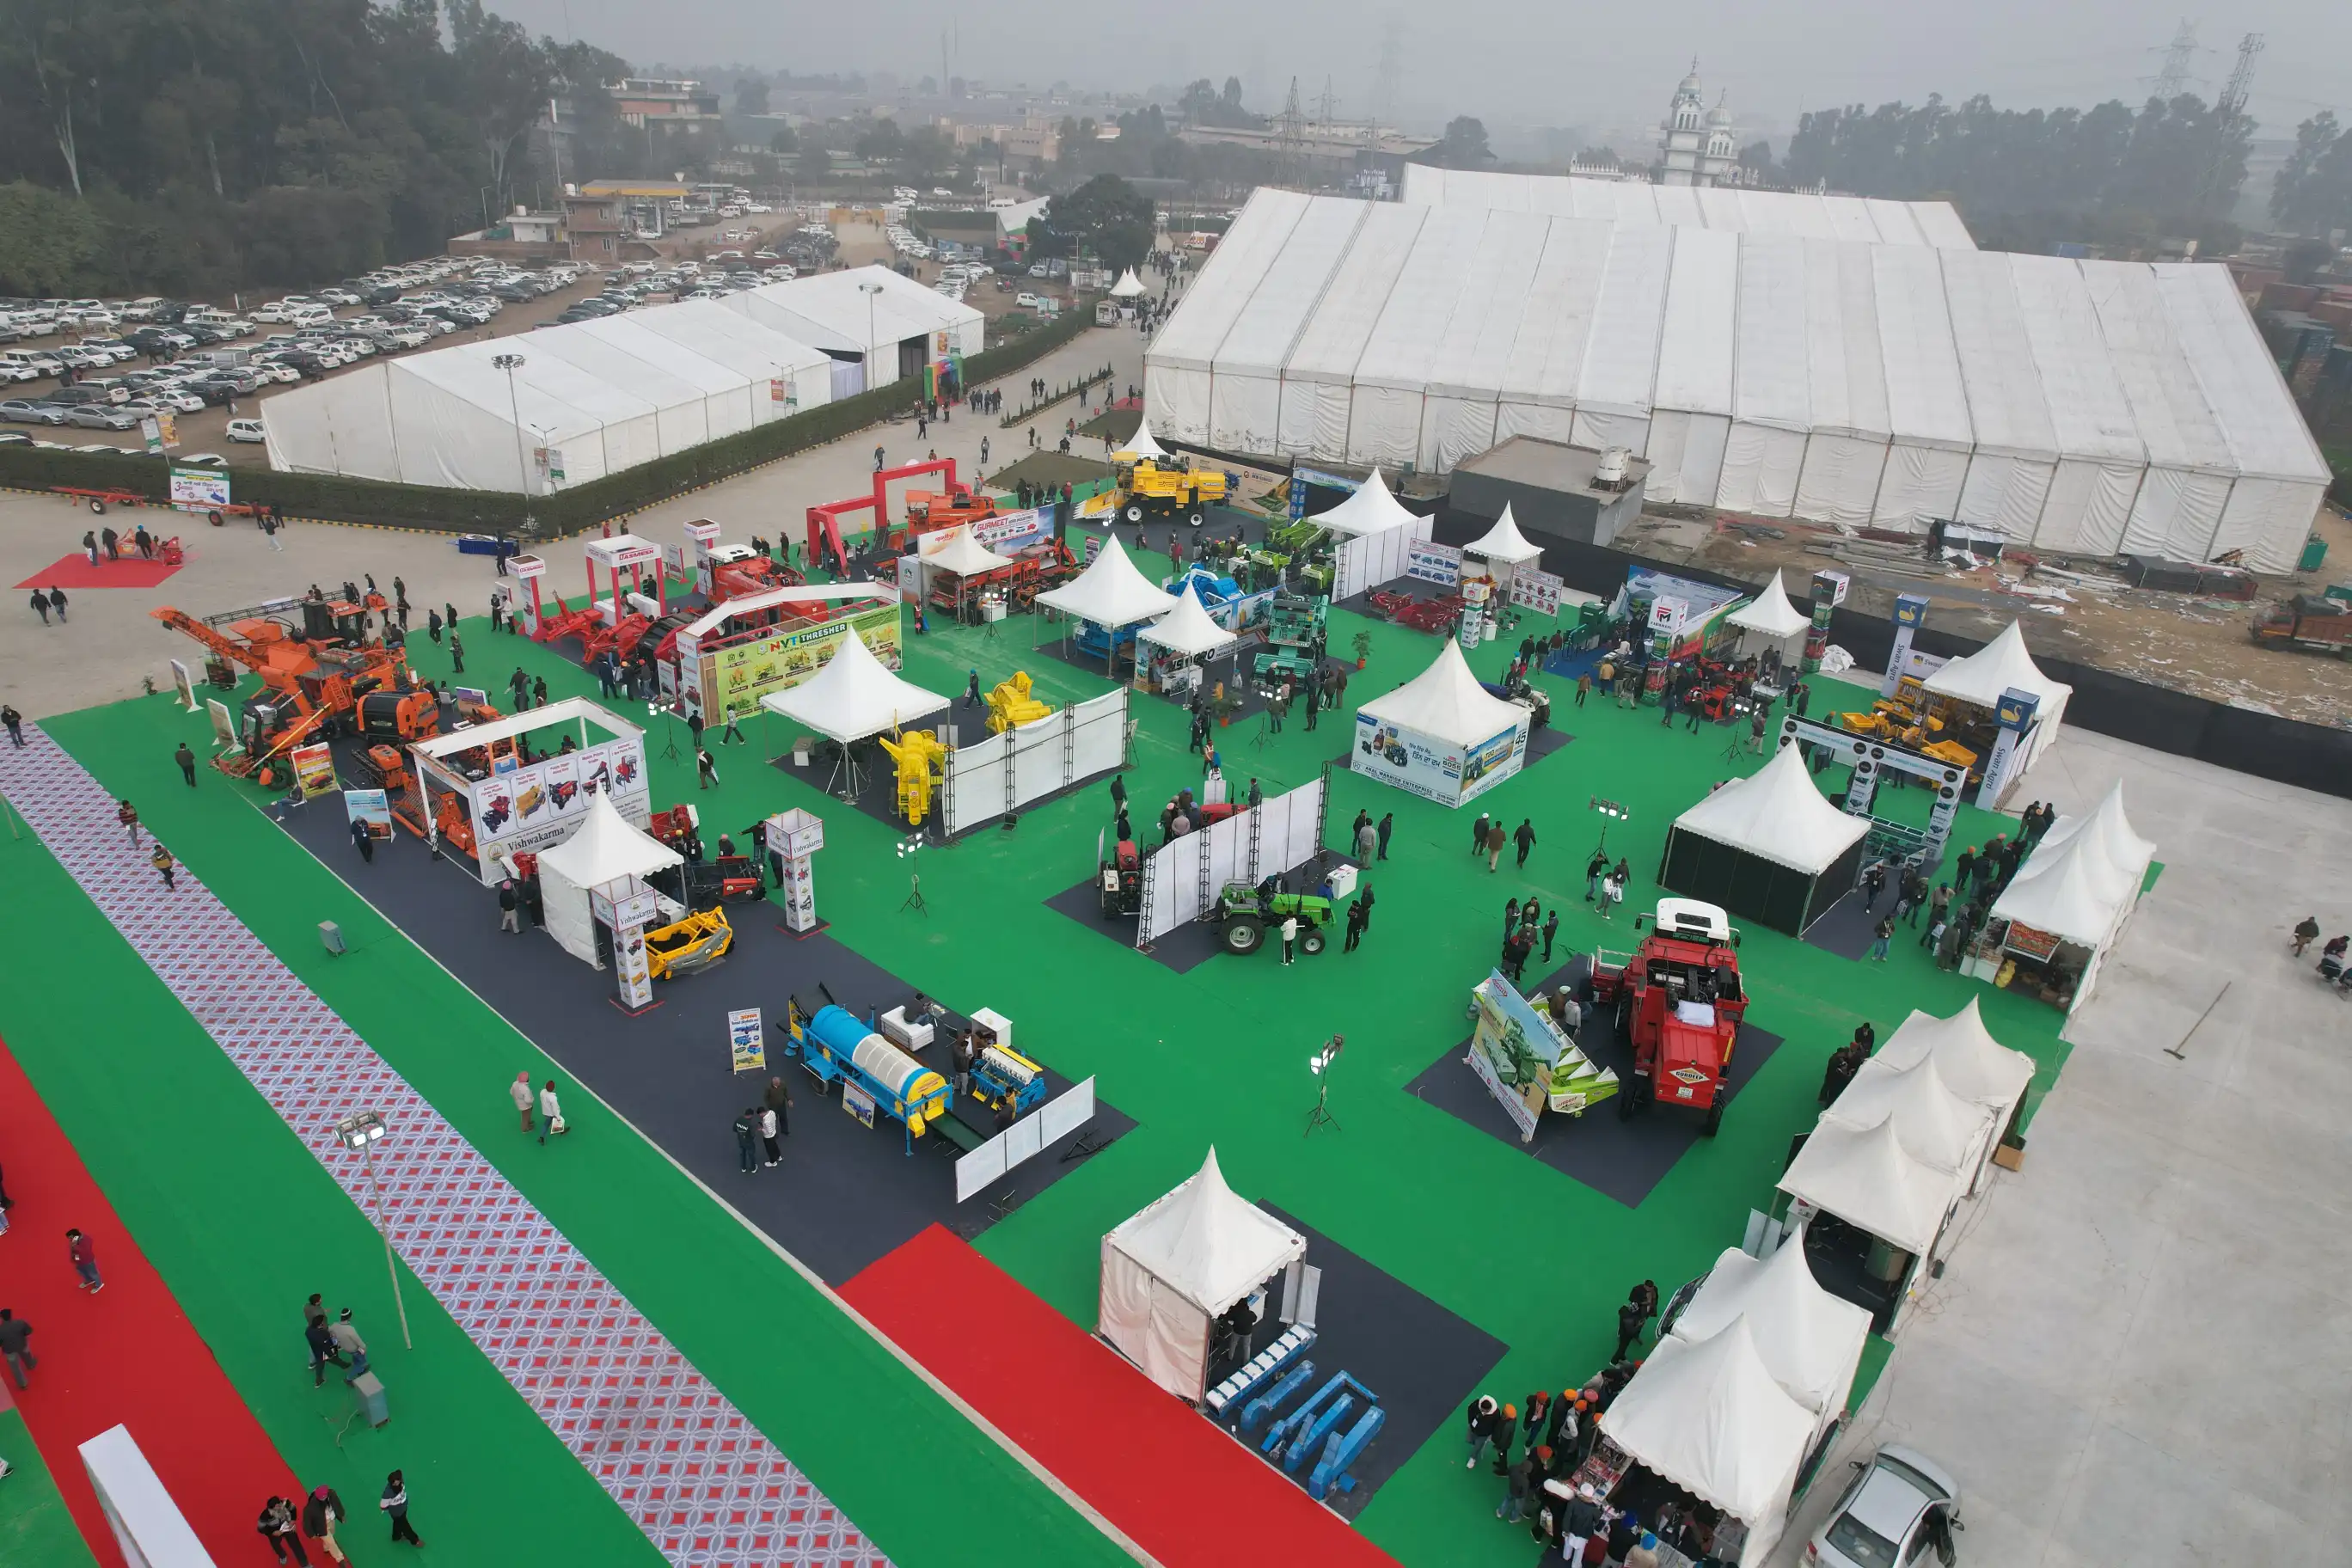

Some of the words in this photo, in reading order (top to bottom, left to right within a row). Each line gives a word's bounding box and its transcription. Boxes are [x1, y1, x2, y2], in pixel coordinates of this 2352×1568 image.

[977, 518, 1008, 531] GURMEET
[619, 548, 654, 560] DASMESH
[769, 635, 799, 653] NVT
[800, 623, 847, 643] THRESHER
[1894, 643, 1905, 664] Swan
[1889, 664, 1899, 682] Agro
[1515, 730, 1528, 746] 45
[1442, 760, 1461, 771] 6055
[1992, 746, 2006, 769] Swan
[1379, 771, 1401, 783] WARRIOR
[1402, 781, 1433, 794] ENTERPRISE
[1985, 770, 1998, 790] Agro
[507, 826, 565, 851] Vishwakarma
[620, 907, 655, 926] Vishwakarma
